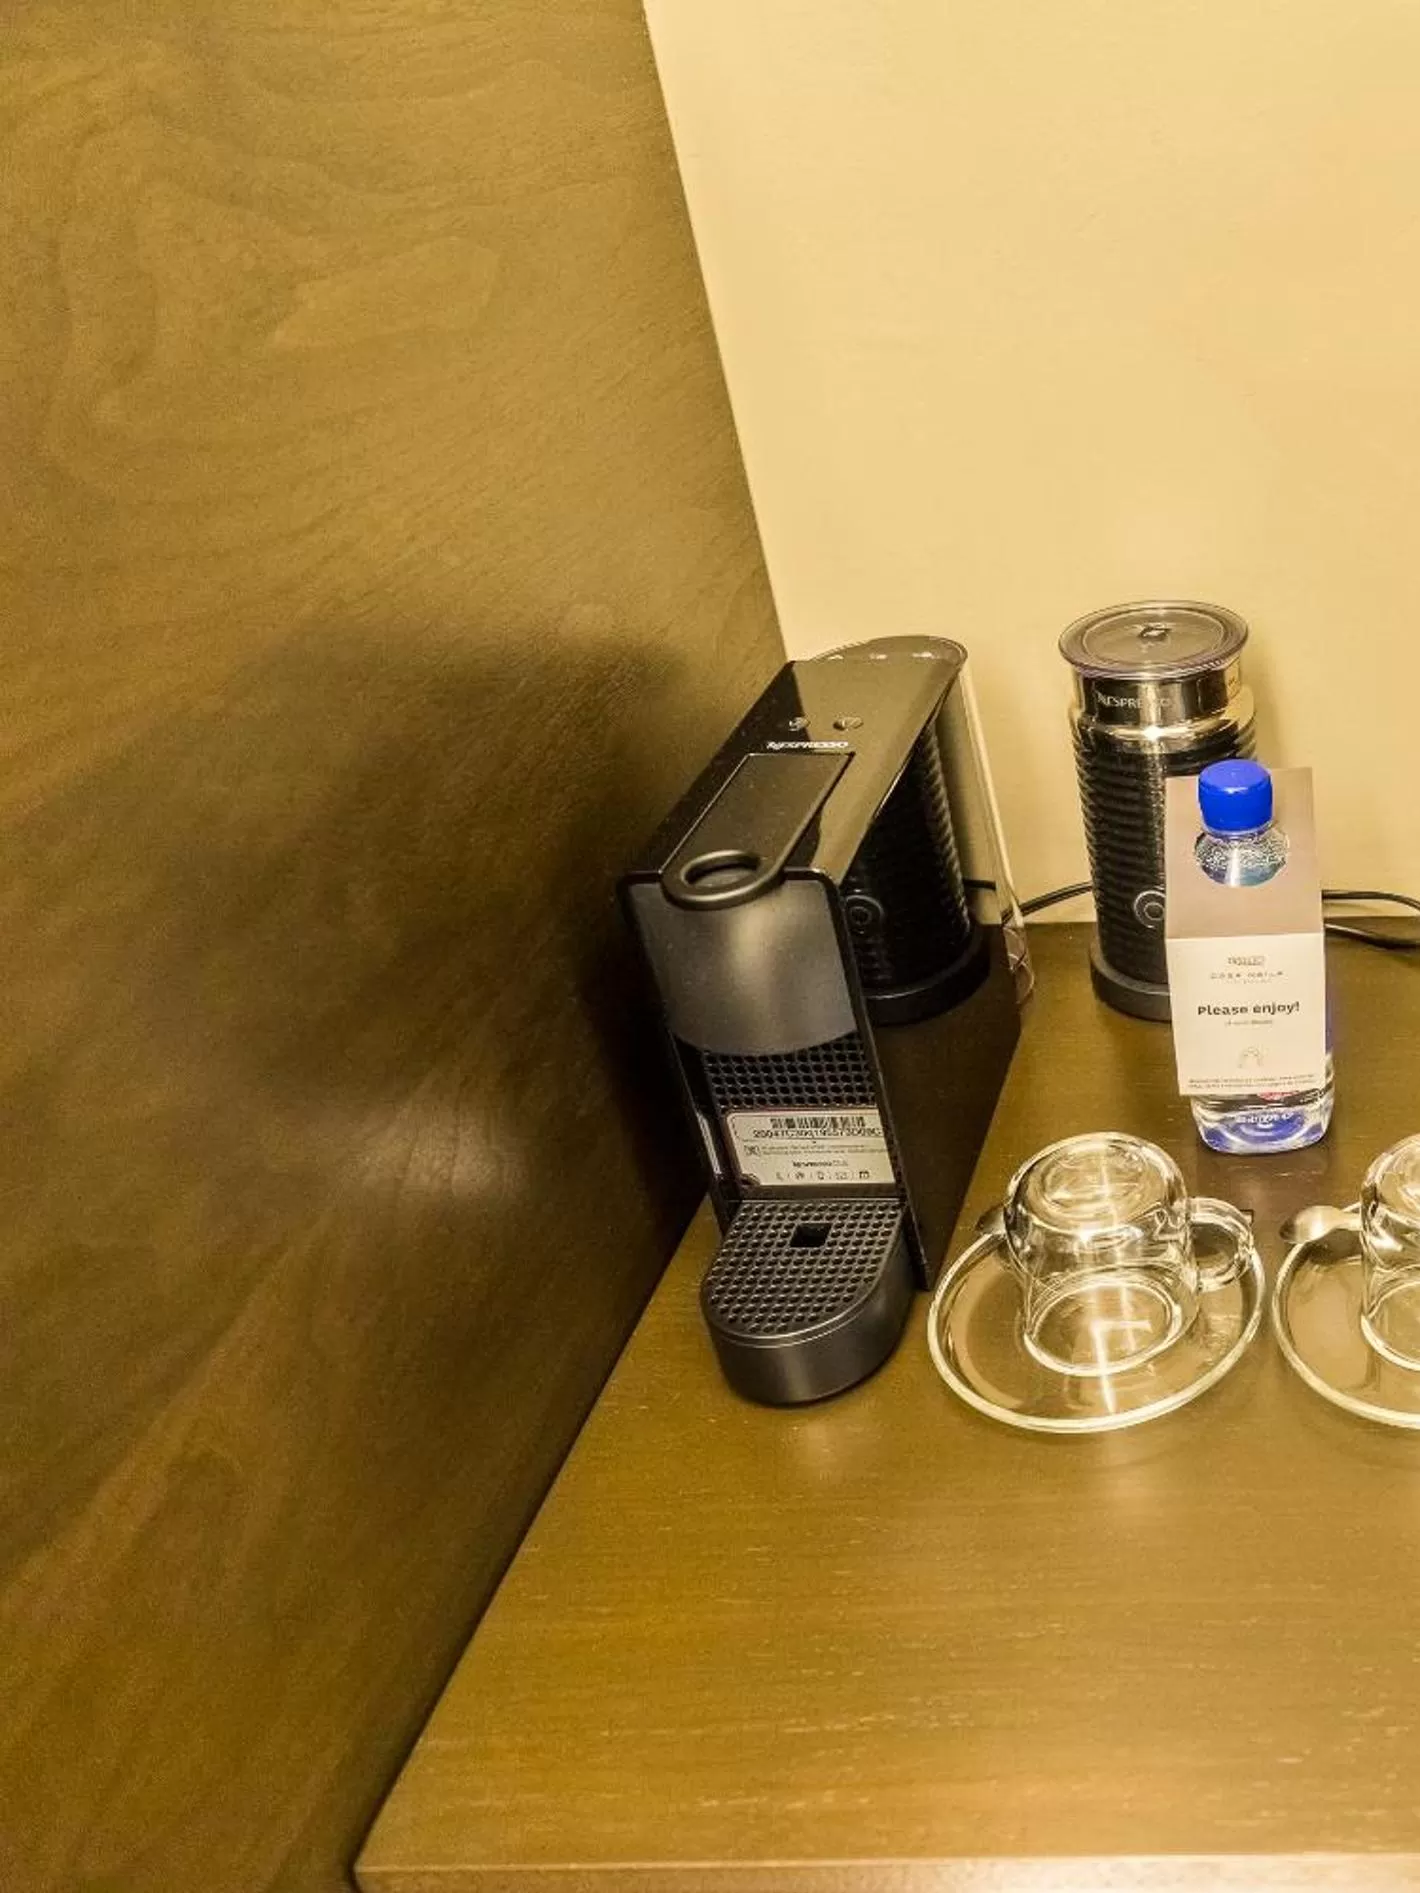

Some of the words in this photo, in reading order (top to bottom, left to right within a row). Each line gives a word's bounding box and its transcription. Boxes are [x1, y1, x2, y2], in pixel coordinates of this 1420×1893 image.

[1098, 694, 1174, 709] NESPREO
[1198, 1004, 1248, 1016] Please
[1253, 1001, 1300, 1016] enjoy!
